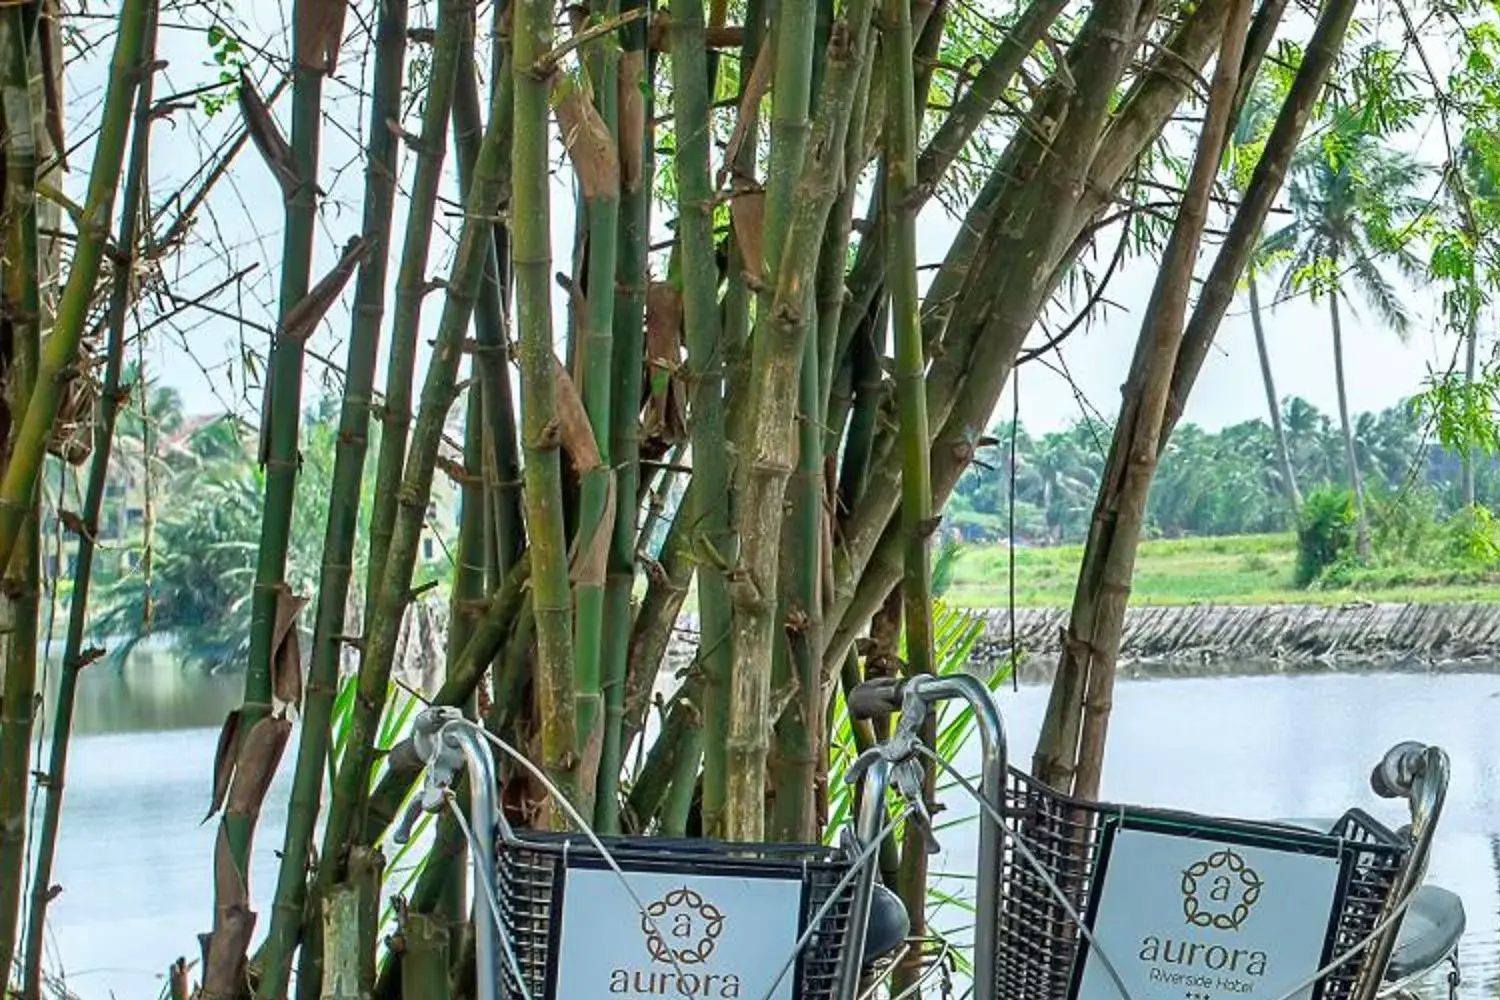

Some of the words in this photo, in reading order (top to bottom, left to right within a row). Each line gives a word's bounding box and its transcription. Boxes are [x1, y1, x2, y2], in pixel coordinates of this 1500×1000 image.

[1210, 875, 1231, 901] a
[672, 914, 692, 938] a
[1138, 935, 1267, 977] aurora
[609, 968, 740, 998] aurora
[1149, 967, 1213, 988] Riverside
[1215, 977, 1254, 994] Hotel
